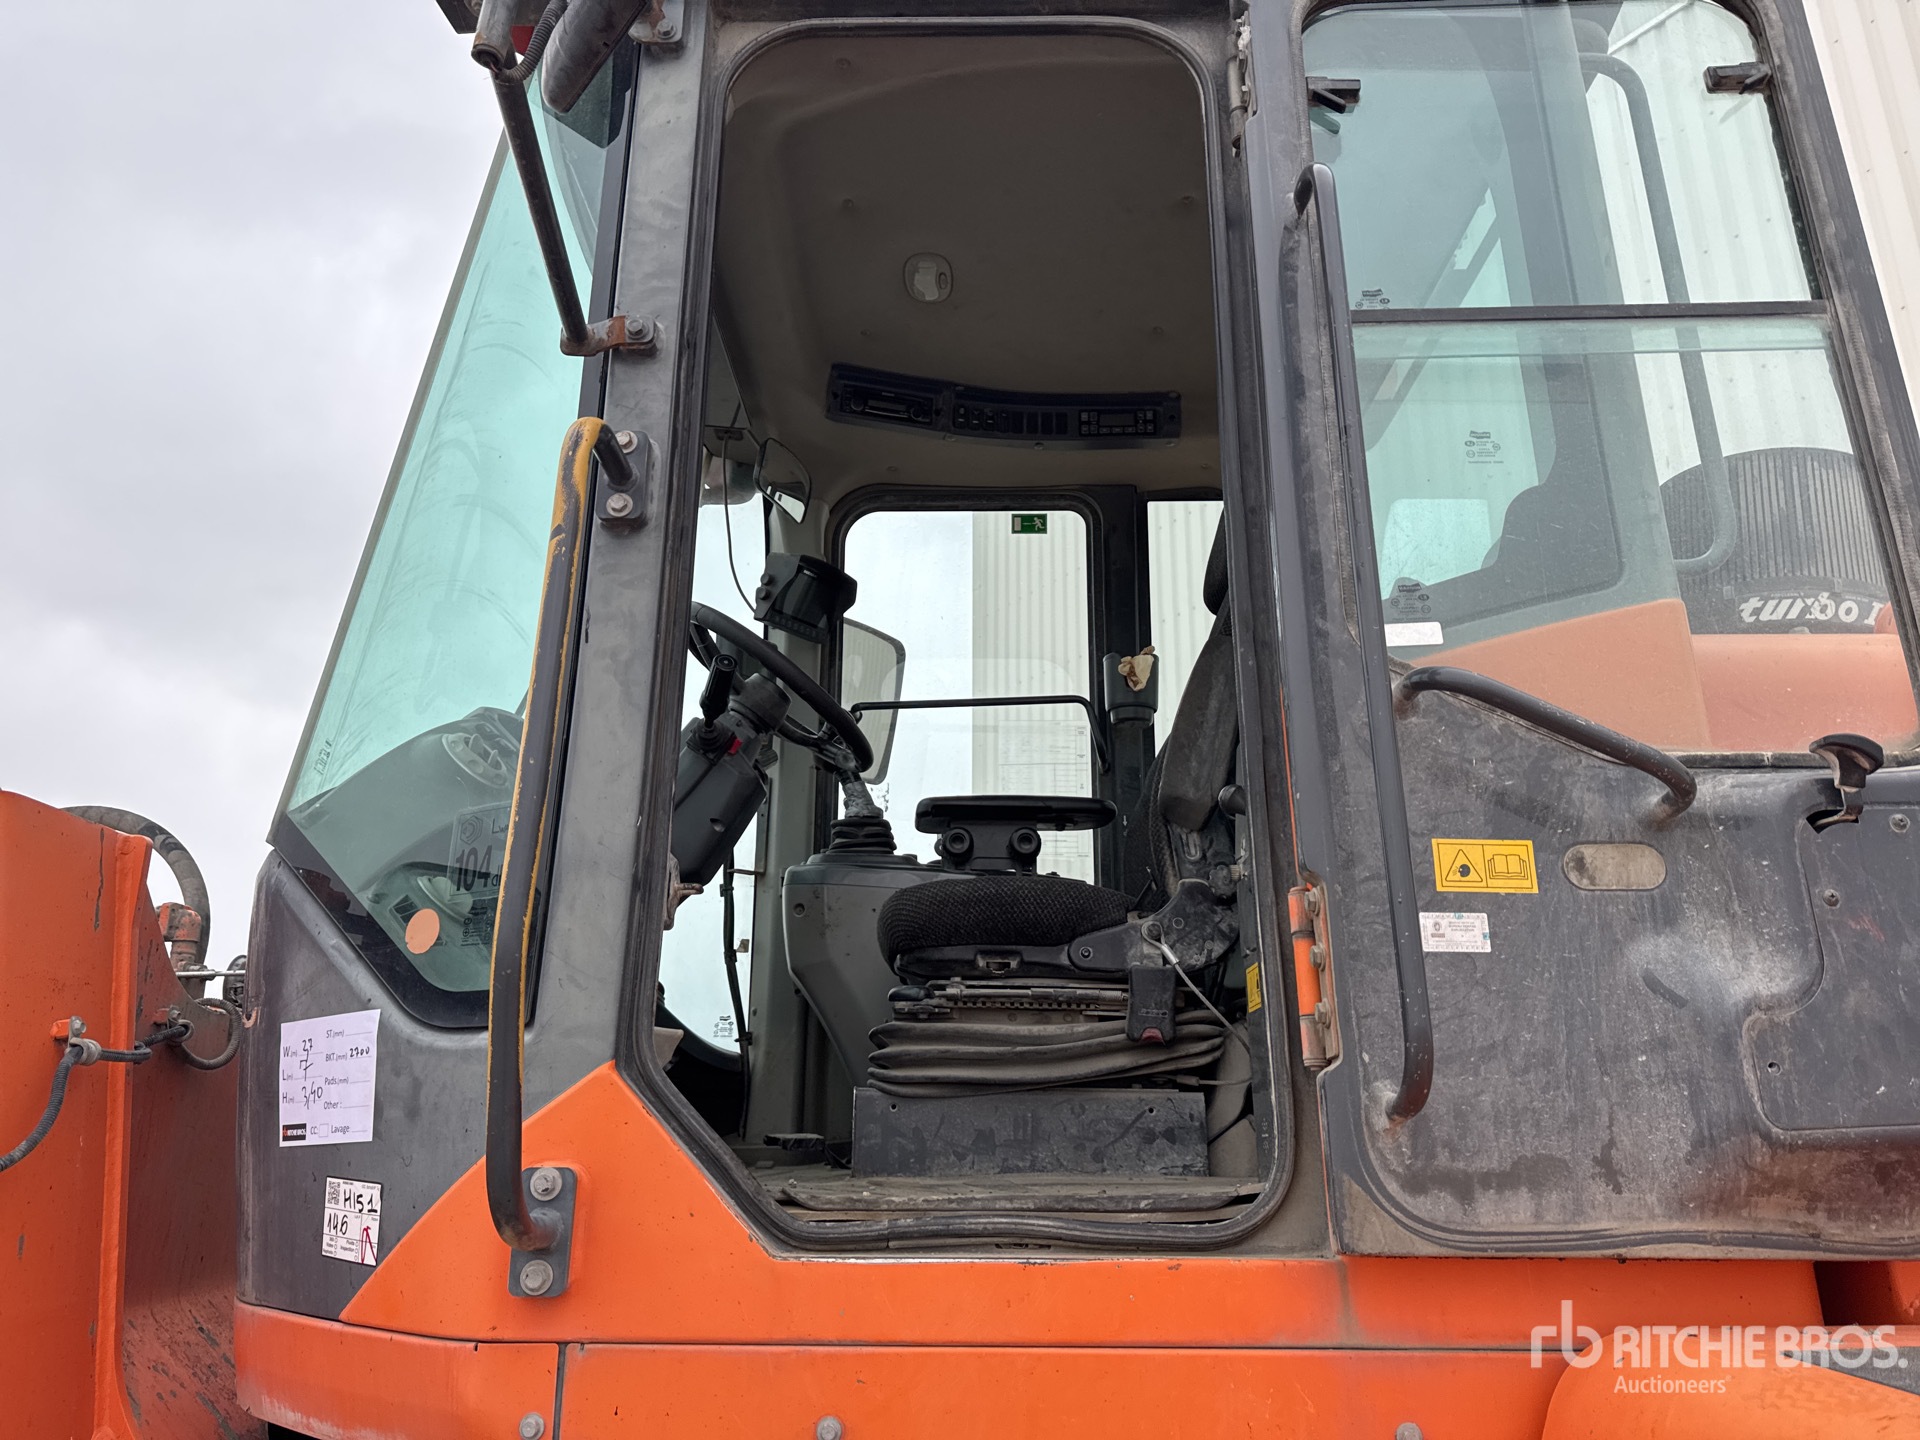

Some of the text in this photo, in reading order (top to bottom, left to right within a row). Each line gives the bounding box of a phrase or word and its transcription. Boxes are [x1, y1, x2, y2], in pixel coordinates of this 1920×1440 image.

[1738, 592, 1859, 623] turbo
[456, 845, 492, 892] 104
[349, 1046, 370, 1058] 2700
[330, 1125, 350, 1135] Lavage
[327, 1212, 348, 1236] 146
